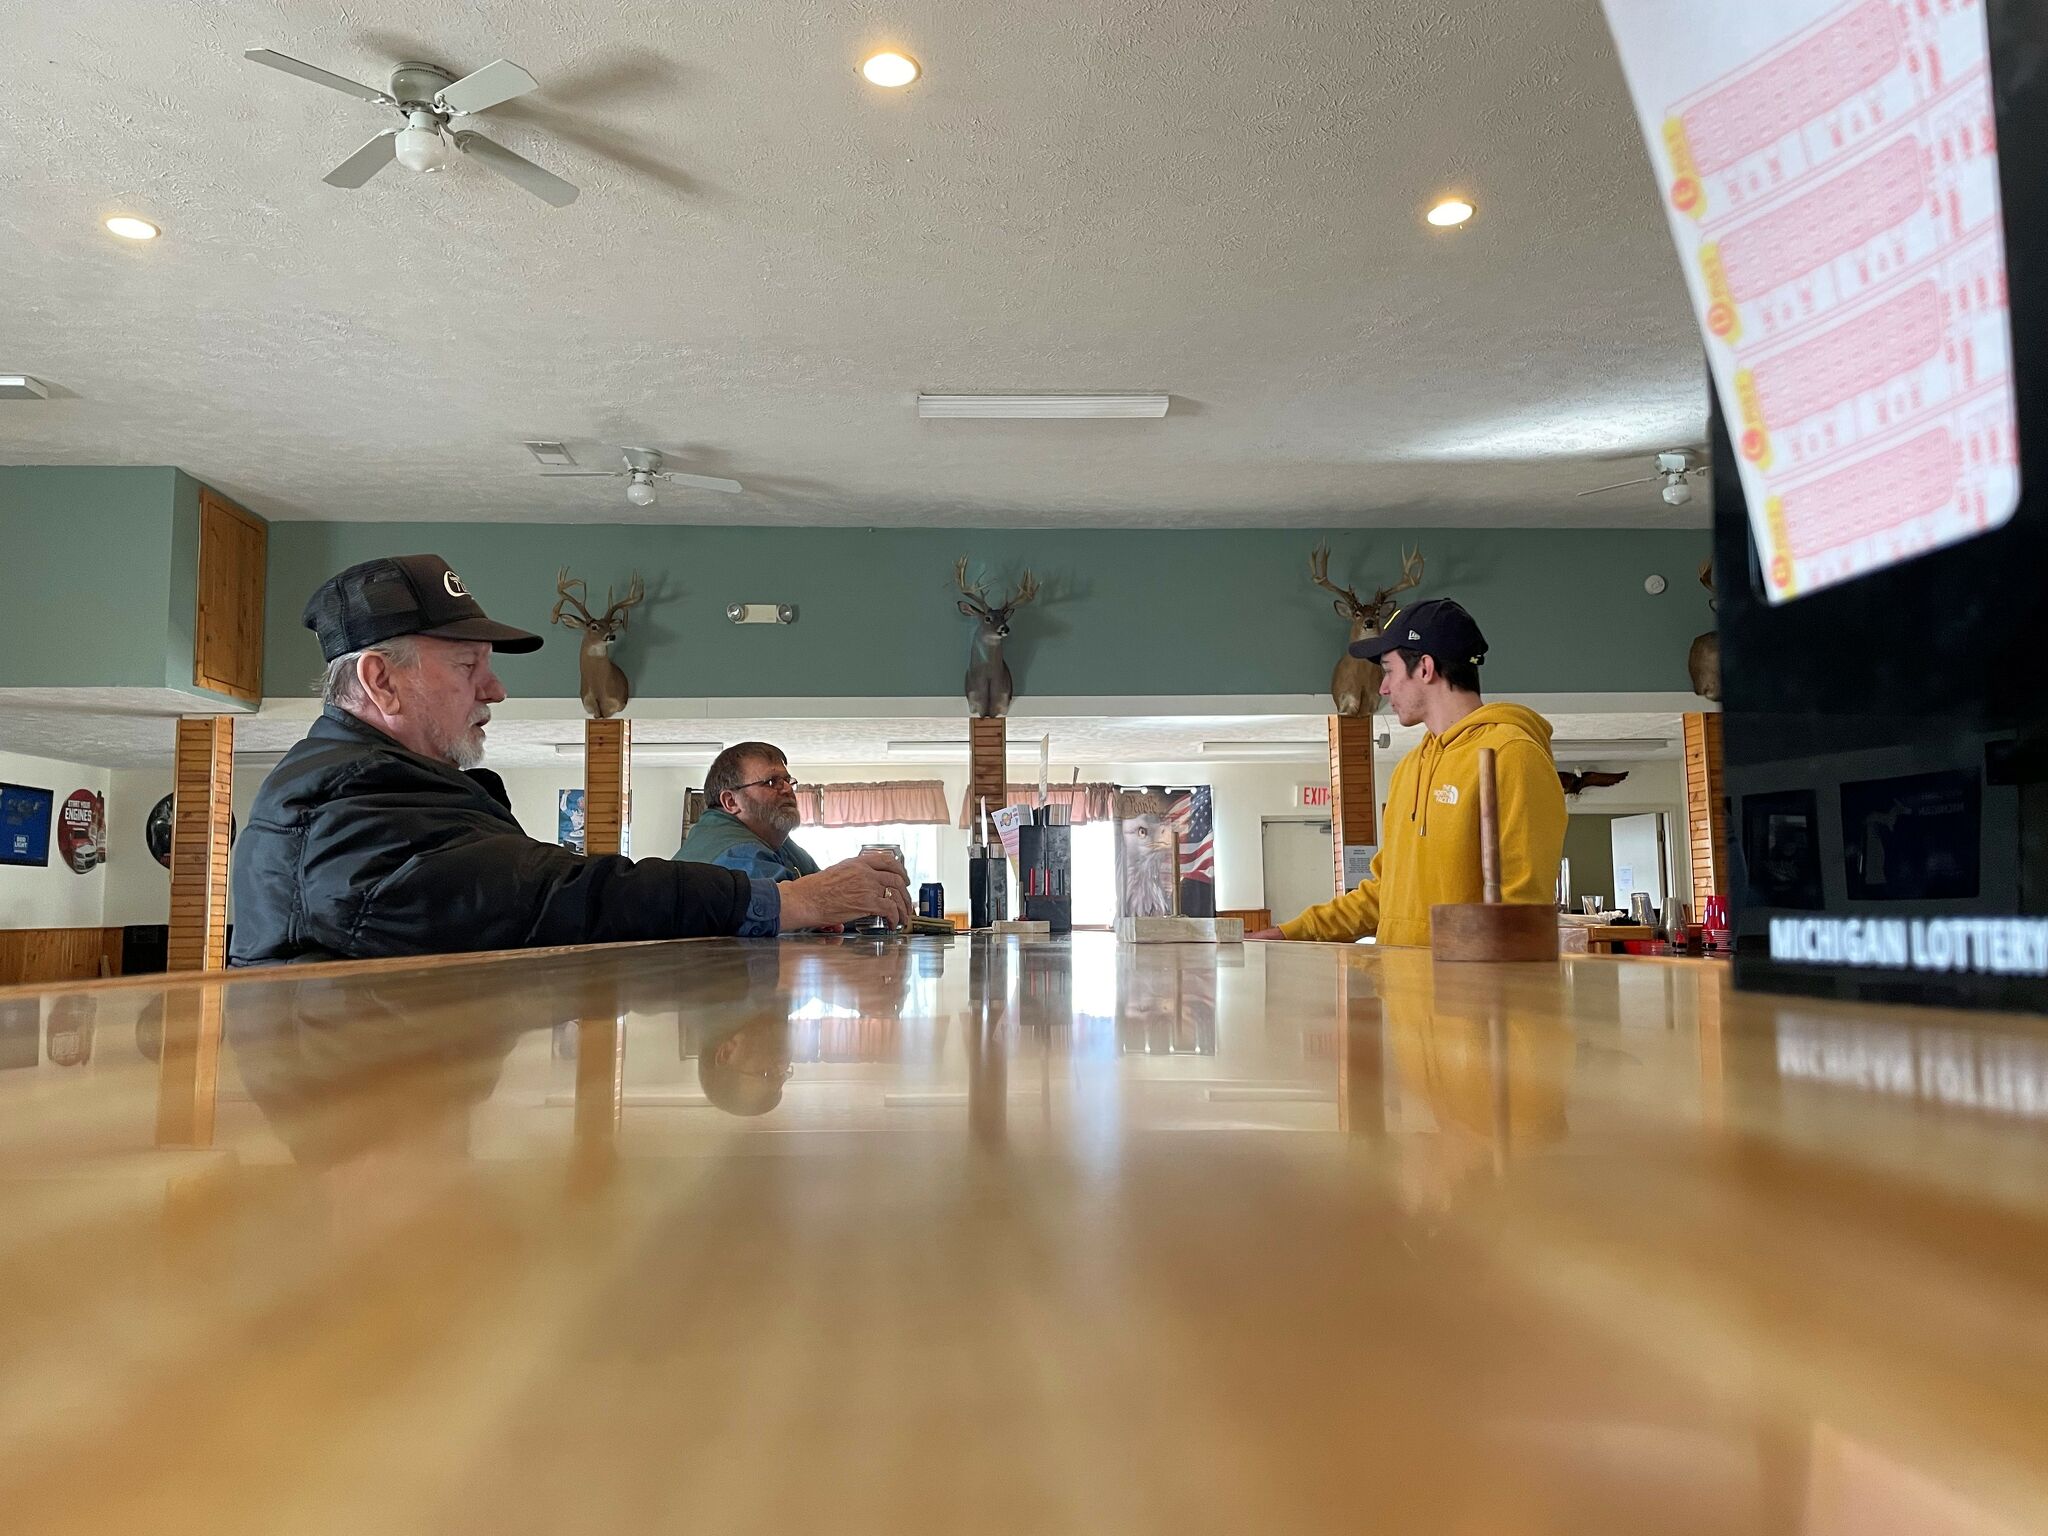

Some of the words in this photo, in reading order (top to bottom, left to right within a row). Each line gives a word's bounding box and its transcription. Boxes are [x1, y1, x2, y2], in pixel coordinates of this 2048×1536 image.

[1303, 786, 1328, 806] EXIT
[65, 807, 92, 821] ENGINES
[1769, 918, 1908, 964] MICHIGAN
[1911, 918, 2048, 974] LOTTERY
